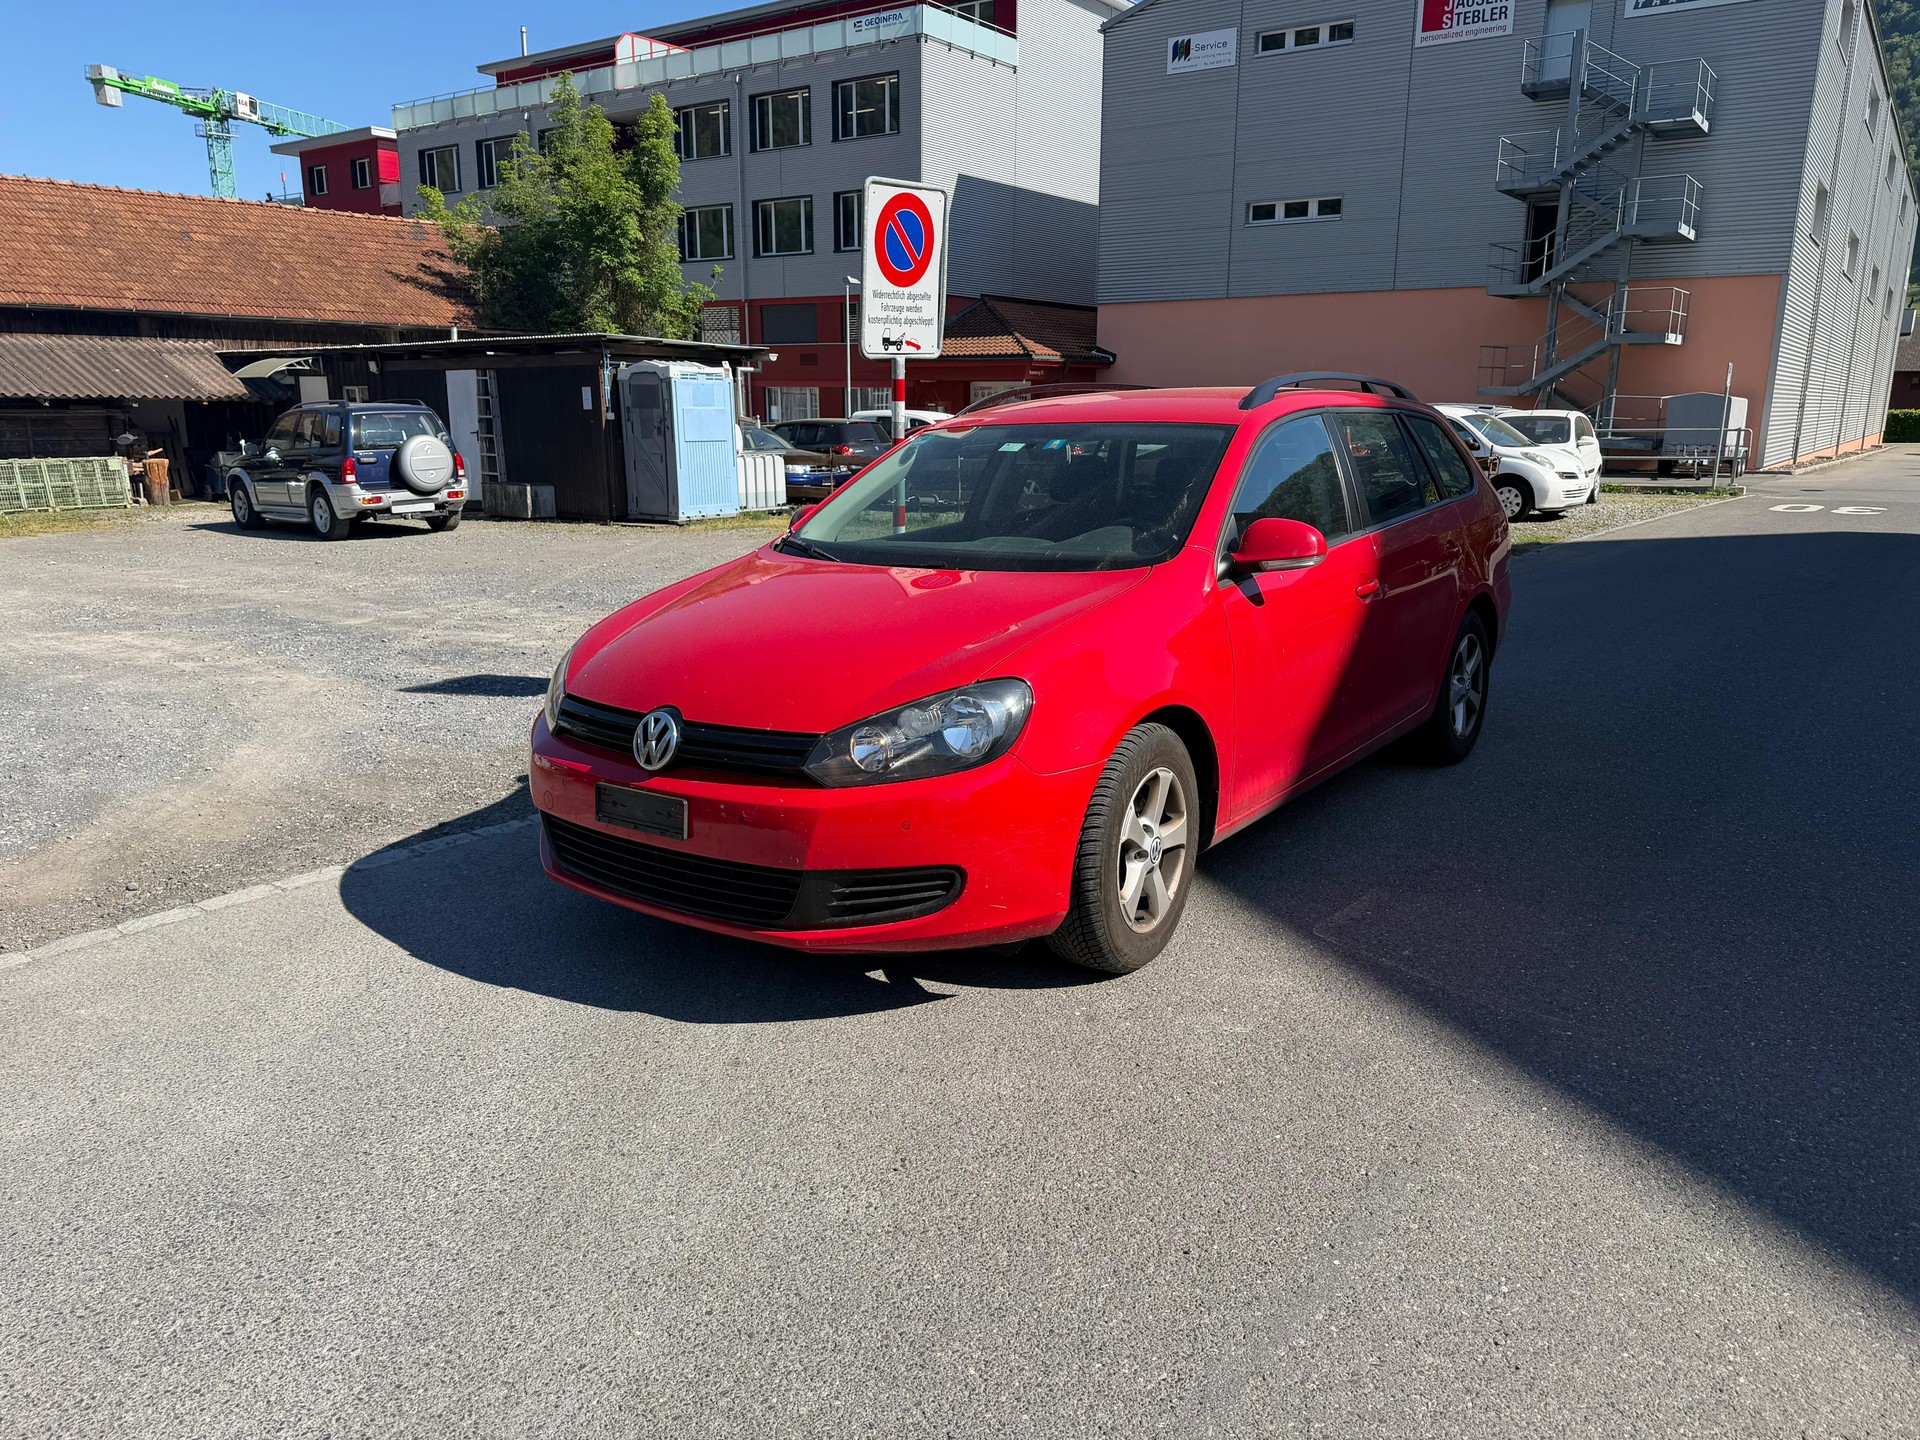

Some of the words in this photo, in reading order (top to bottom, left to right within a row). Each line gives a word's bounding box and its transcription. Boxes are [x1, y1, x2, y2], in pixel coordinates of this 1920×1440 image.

[864, 12, 903, 27] GEOINFRA
[1442, 5, 1508, 29] STEBLER
[1420, 29, 1463, 44] personalized
[1465, 24, 1507, 37] engineering
[872, 289, 905, 300] Widerrechtlich
[907, 291, 931, 303] abgestellte
[881, 302, 904, 315] Fahrzeuge
[906, 304, 922, 313] werden
[868, 314, 902, 328] kostenpflichtig
